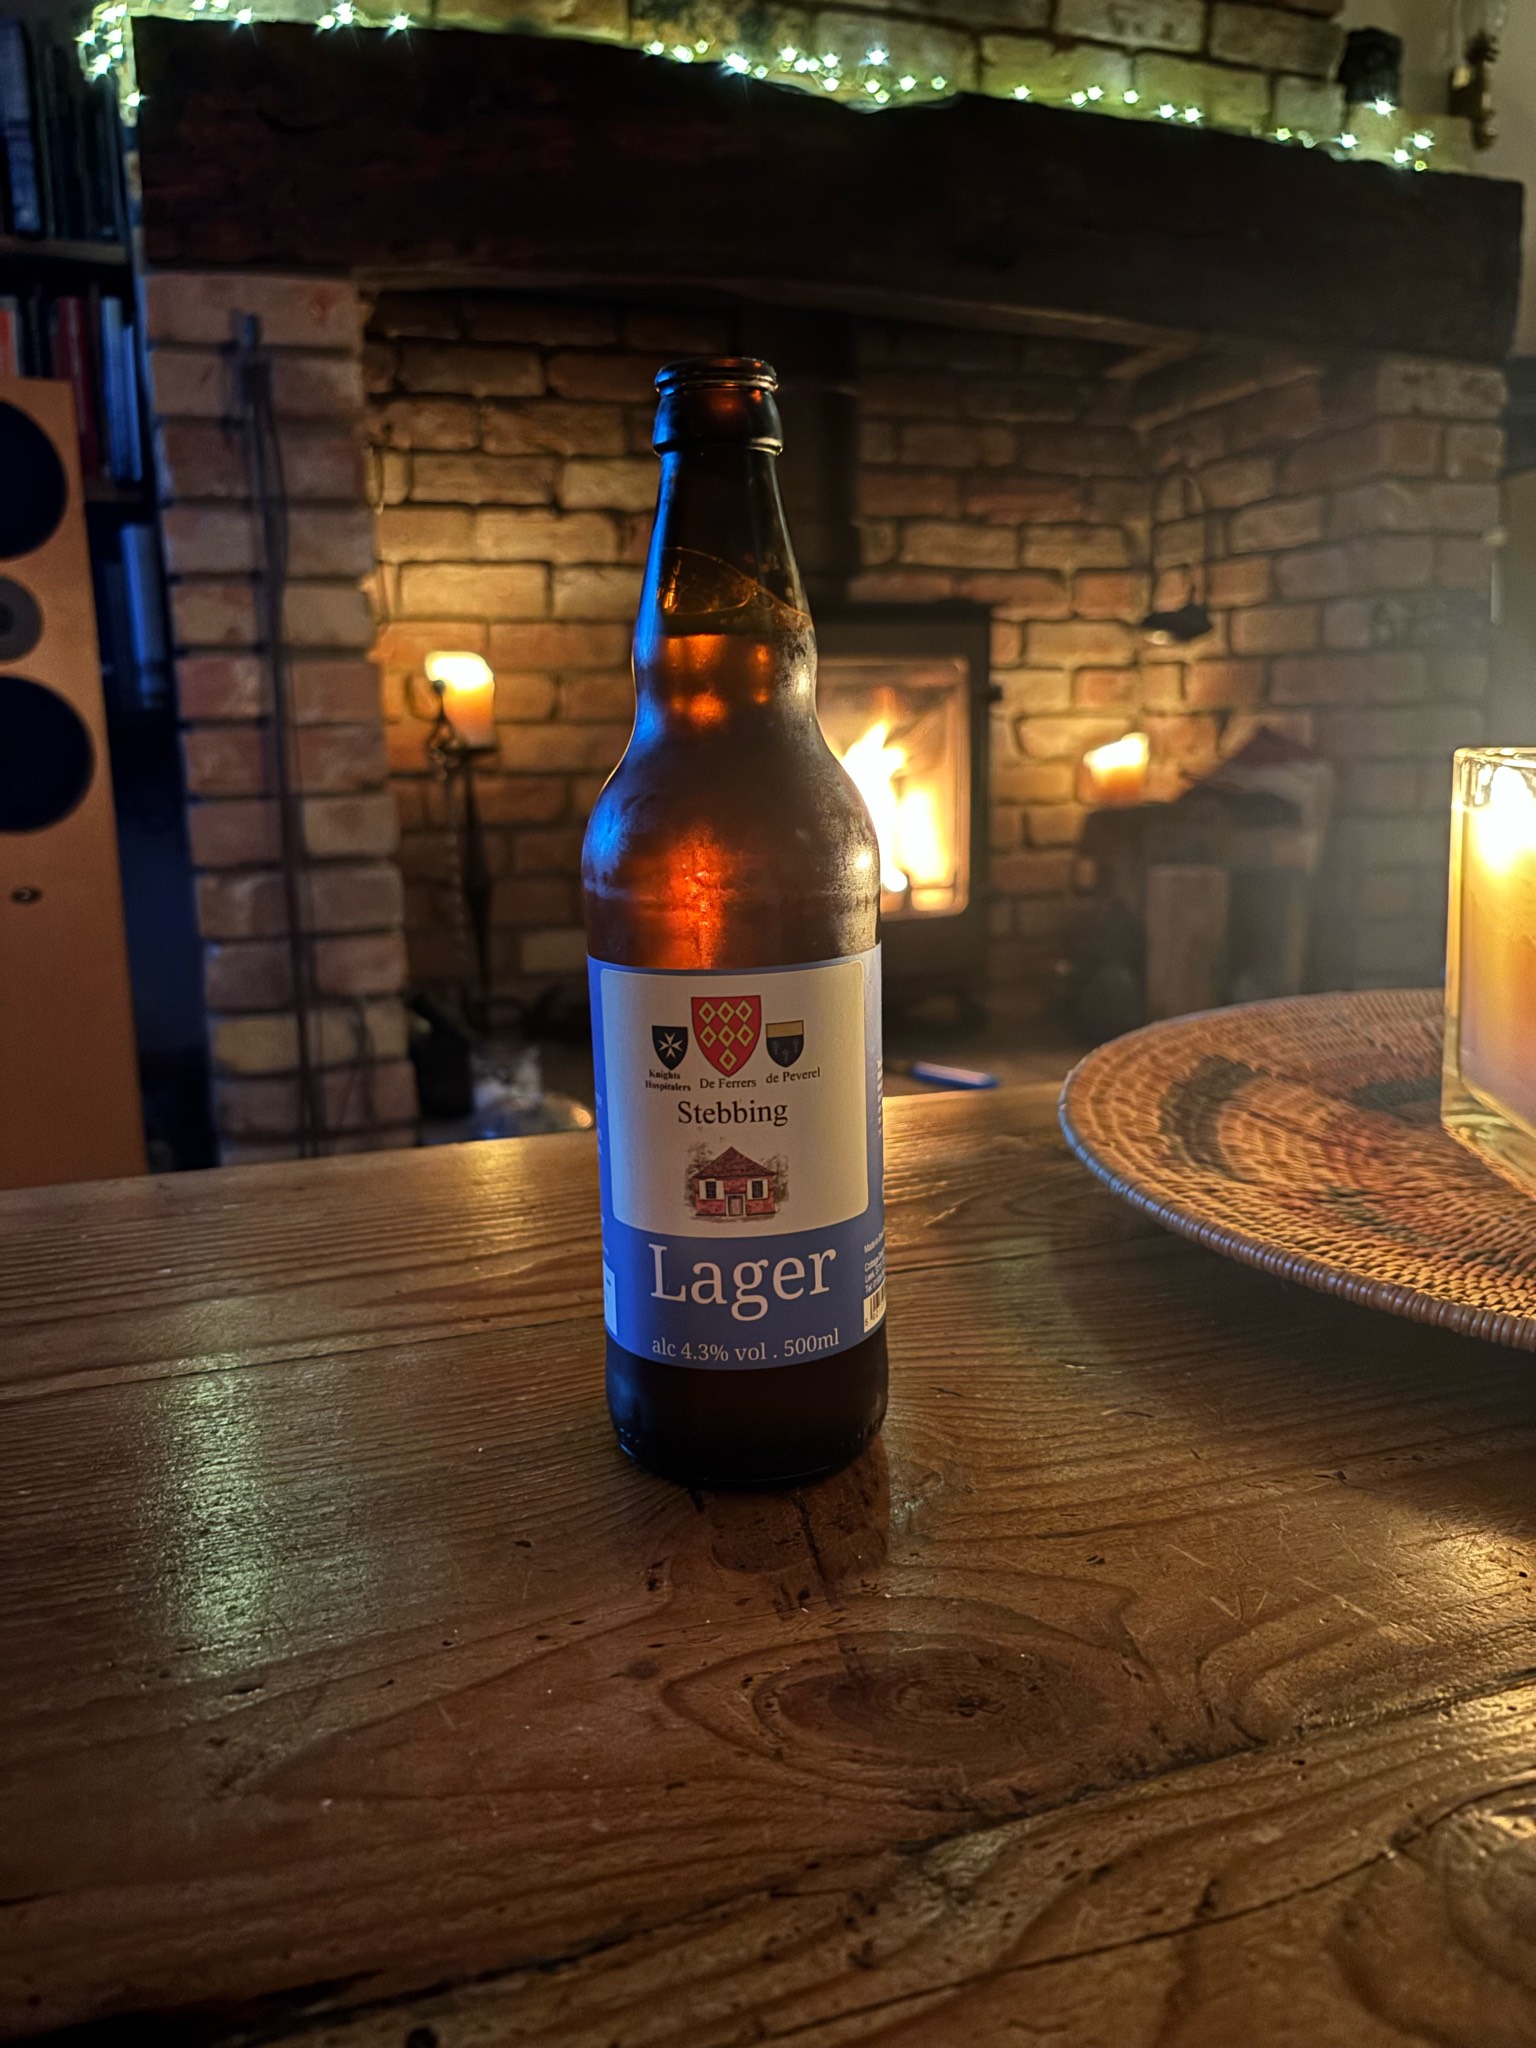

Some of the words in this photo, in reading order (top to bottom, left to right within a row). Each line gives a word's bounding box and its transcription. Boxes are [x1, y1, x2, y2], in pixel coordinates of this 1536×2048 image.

[649, 1069, 681, 1081] Knights
[700, 1078, 715, 1089] De
[718, 1078, 757, 1089] Ferrers
[766, 1072, 779, 1084] de
[782, 1067, 821, 1083] Peverel
[645, 1080, 692, 1092] Hospitalers
[677, 1100, 789, 1127] Stebbing
[648, 1243, 837, 1321] Lager
[652, 1337, 676, 1357] alc
[680, 1342, 729, 1361] 4.3%
[735, 1342, 767, 1361] vol
[784, 1328, 840, 1358] 500ml
